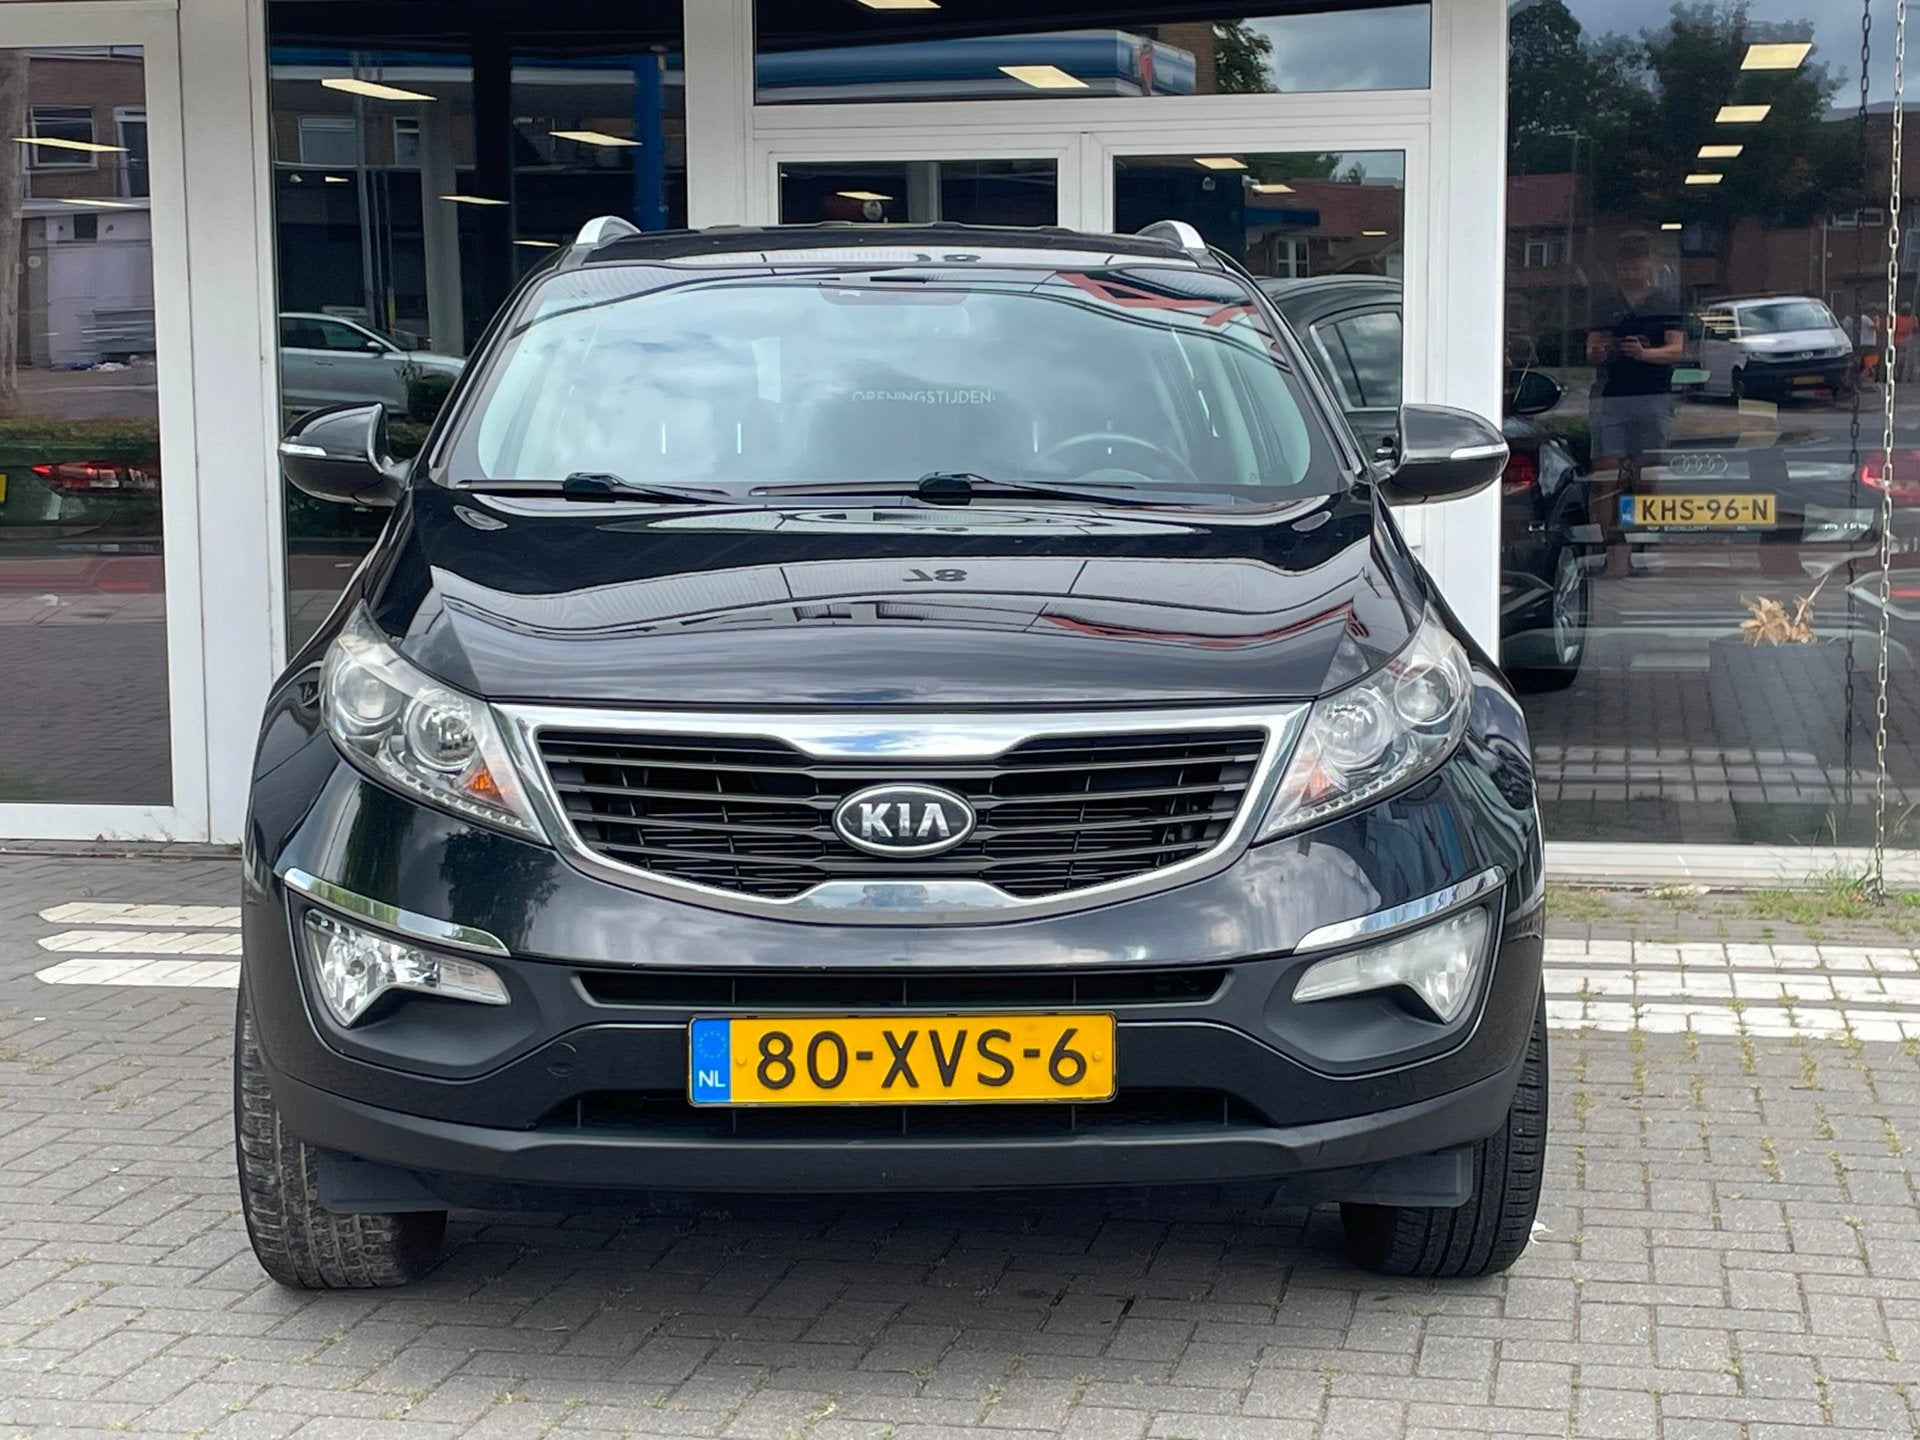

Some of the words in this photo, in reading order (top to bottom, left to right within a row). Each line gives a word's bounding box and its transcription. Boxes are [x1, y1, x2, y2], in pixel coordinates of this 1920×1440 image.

[1642, 499, 1768, 521] KHS-96-N
[859, 803, 950, 837] KIA
[698, 1070, 726, 1089] NL
[756, 1028, 1088, 1091] 80-XVS-6
